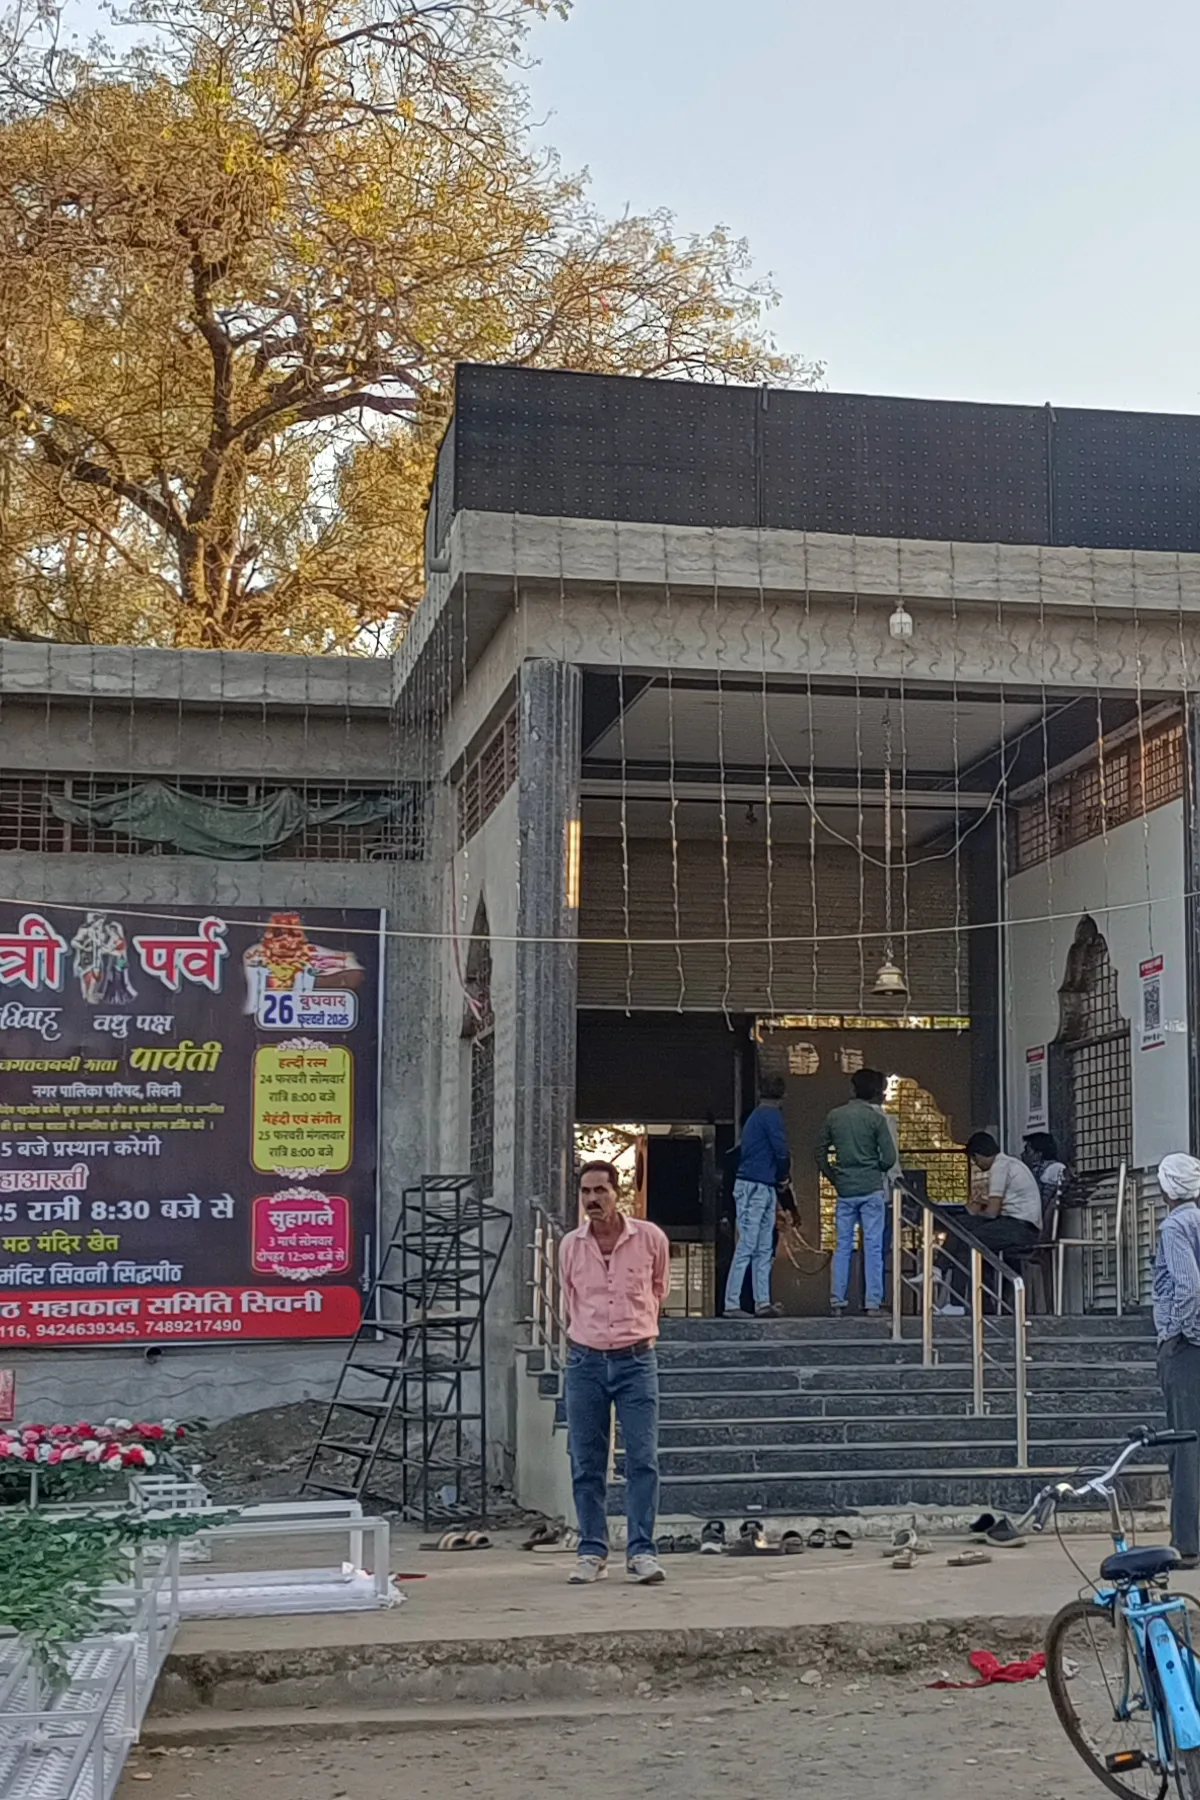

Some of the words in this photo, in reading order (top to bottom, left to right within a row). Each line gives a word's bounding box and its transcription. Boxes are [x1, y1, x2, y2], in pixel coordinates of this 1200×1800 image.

[132, 915, 228, 992] पर्व
[263, 994, 294, 1025] 26
[298, 994, 346, 1011] बुधवार
[93, 1014, 132, 1039] वधु
[136, 1014, 175, 1035] पक्ष
[327, 1014, 349, 1026] 2025
[130, 1040, 223, 1072] पार्वती
[279, 1055, 305, 1069] हल्दी
[275, 1072, 308, 1084] फरवरी
[32, 1085, 58, 1098] नगर
[60, 1082, 103, 1098] पालिका
[146, 1082, 182, 1098] सिवनी
[268, 1089, 289, 1102] रात्रि
[291, 1092, 317, 1102] 8:00
[318, 1089, 336, 1102] बजे
[262, 1111, 291, 1125] मेहंदी
[292, 1112, 309, 1125] एवं
[310, 1111, 342, 1125] संगीत
[258, 1130, 271, 1141] 25
[273, 1127, 305, 1140] फरवरी
[0, 1141, 12, 1157] 5
[16, 1135, 50, 1157] बजे
[52, 1141, 110, 1157] प्रस्थान
[113, 1135, 163, 1157] करेगी
[268, 1145, 289, 1158] रात्रि
[290, 1147, 316, 1158] 8:00
[317, 1144, 334, 1158] बजे
[26, 1195, 82, 1221] रात्री
[91, 1200, 150, 1221] 8:30
[160, 1193, 202, 1219] बजे
[209, 1193, 235, 1219] से
[267, 1205, 335, 1233] सुहागले
[1, 1236, 32, 1253] मठ
[35, 1228, 83, 1255] मंदिर
[85, 1228, 121, 1251] खेत
[268, 1236, 276, 1248] 3
[277, 1233, 297, 1246] मार्च
[287, 1251, 316, 1262] 12:00
[316, 1248, 334, 1262] बजे
[0, 1263, 47, 1286] मंदिर
[48, 1261, 109, 1285] सिवनी
[111, 1260, 184, 1285] सिद्धपीठ
[27, 1298, 141, 1318] महाकाल
[146, 1291, 234, 1315] समिति
[239, 1290, 323, 1313] सिवनी
[36, 1321, 140, 1337] 9424639345,
[145, 1319, 242, 1334] 7489217490
